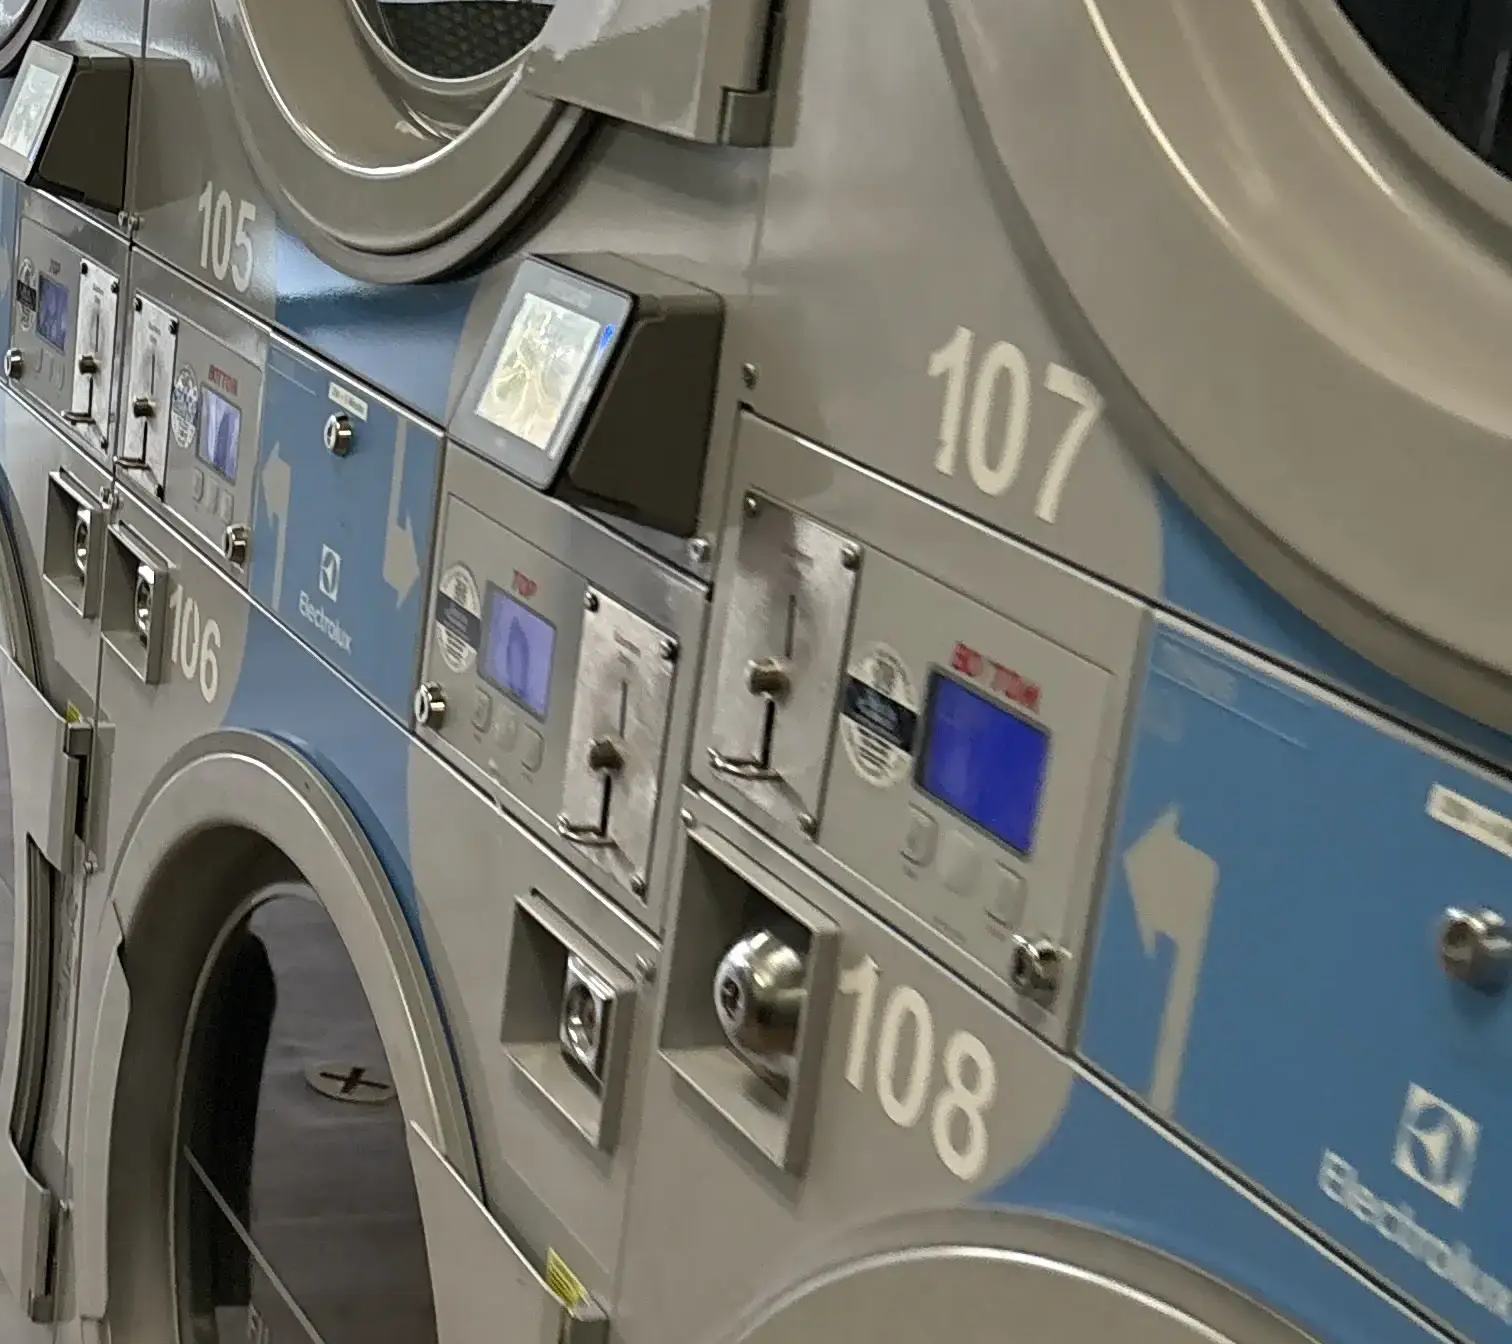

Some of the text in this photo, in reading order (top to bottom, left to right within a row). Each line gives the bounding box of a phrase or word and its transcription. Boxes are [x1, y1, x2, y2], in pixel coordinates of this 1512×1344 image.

[197, 179, 256, 294] 105
[926, 325, 1105, 524] 107
[167, 582, 222, 702] 106
[297, 587, 354, 656] Electrolux
[838, 952, 999, 1184] 108
